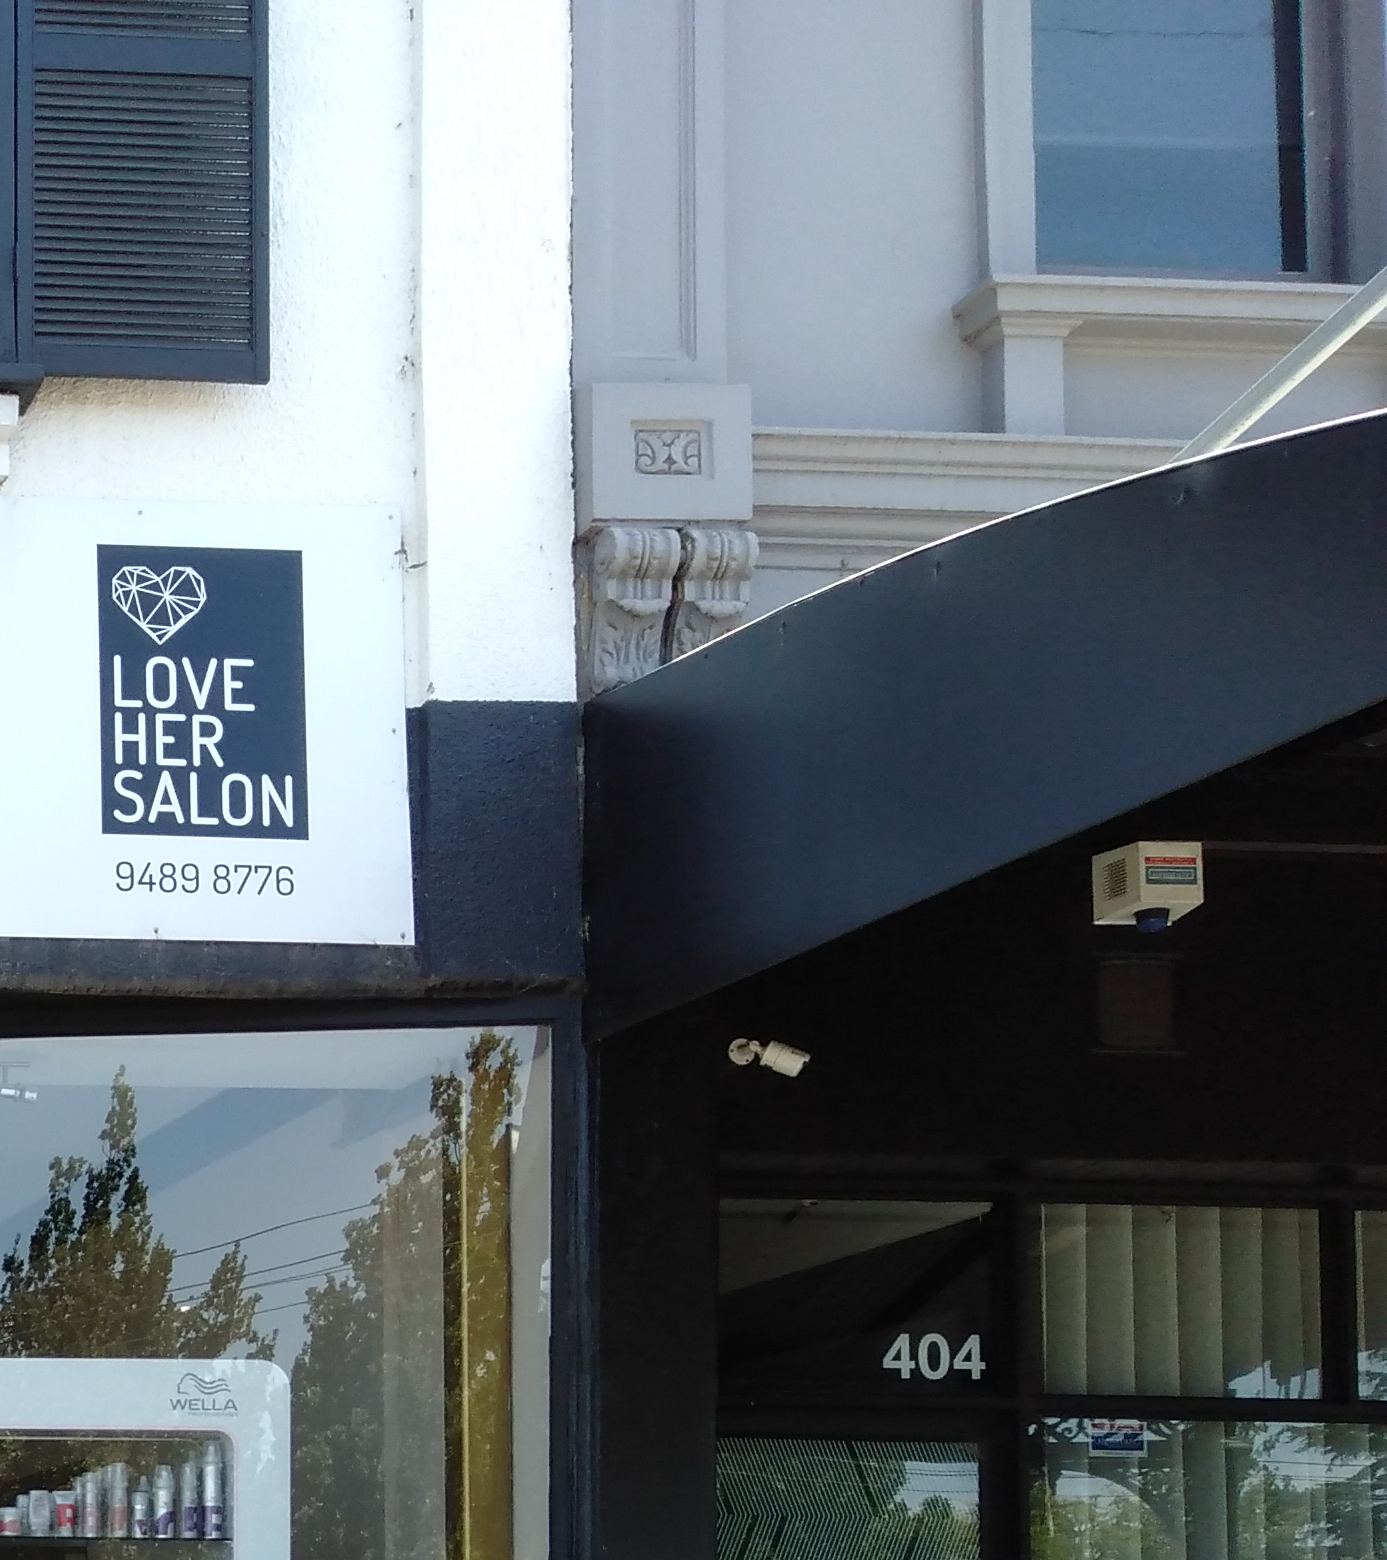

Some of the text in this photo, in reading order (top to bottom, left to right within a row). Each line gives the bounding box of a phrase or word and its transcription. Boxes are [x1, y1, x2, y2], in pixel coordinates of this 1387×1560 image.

[113, 654, 255, 711] LOVE
[114, 712, 224, 767] HER
[113, 770, 294, 827] SALON
[115, 861, 295, 896] 9489 8776
[882, 1333, 987, 1380] 404
[169, 1398, 238, 1411] WELLA
